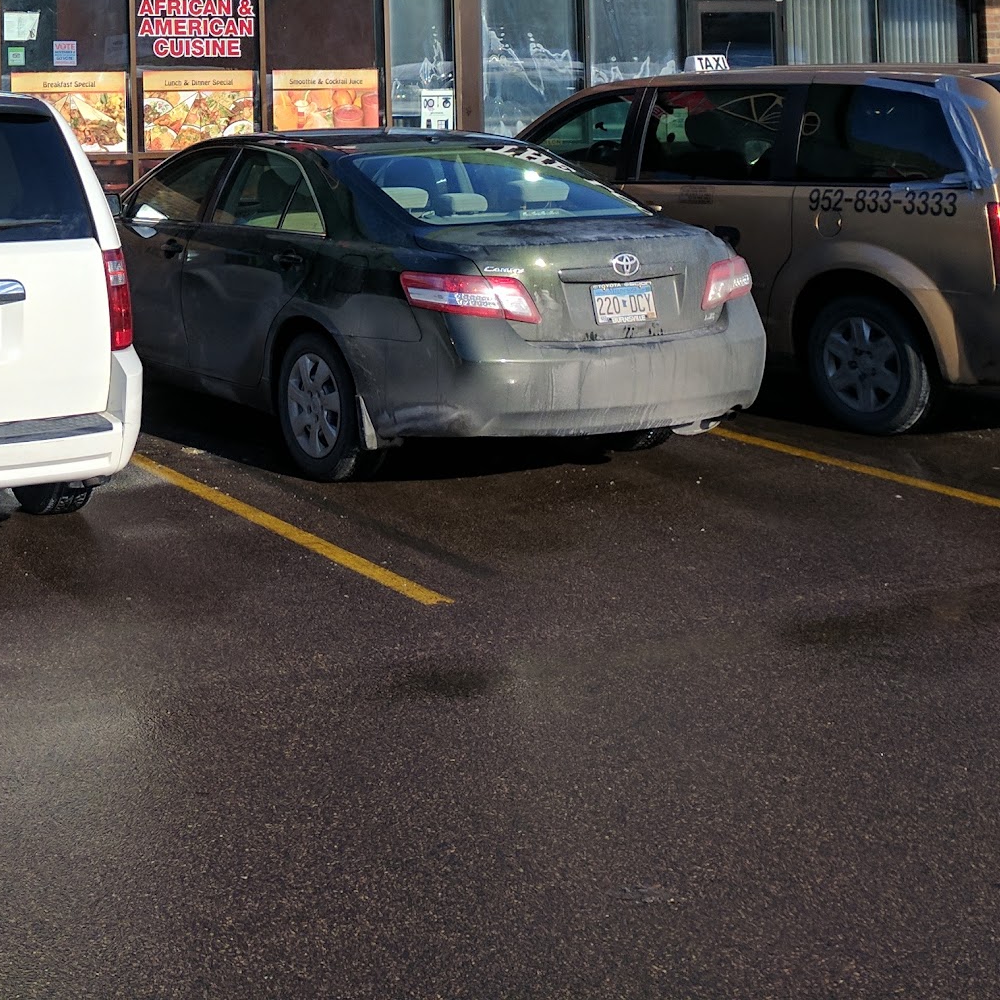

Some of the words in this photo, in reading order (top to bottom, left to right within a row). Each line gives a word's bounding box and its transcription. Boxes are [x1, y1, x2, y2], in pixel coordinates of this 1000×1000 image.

[138, 17, 254, 37] AMERICAN
[153, 38, 241, 58] CUISINE
[697, 56, 728, 71] TAXI
[808, 188, 957, 217] 952-833-3333
[597, 296, 621, 315] 220
[629, 293, 652, 313] DCY
